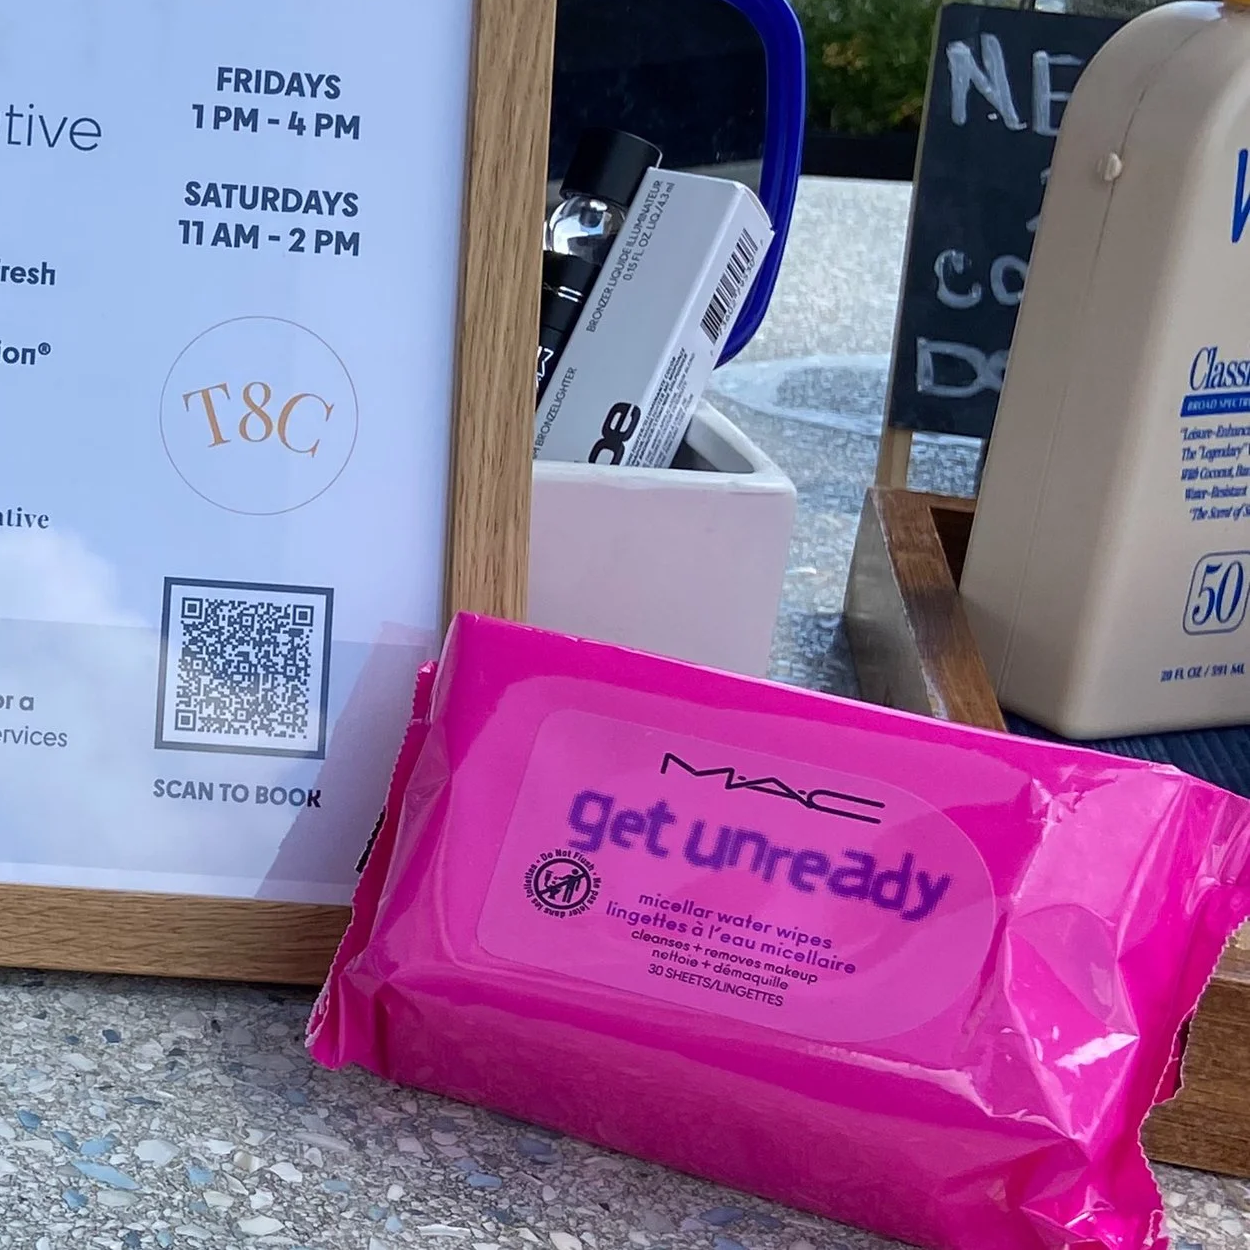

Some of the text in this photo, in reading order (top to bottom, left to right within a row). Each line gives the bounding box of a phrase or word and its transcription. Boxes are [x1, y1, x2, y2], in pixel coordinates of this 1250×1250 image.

[217, 66, 341, 100] FRIDAYS
[192, 104, 204, 129] 1
[213, 105, 259, 133] PM
[287, 111, 306, 136] 4
[314, 112, 360, 140] PM
[184, 181, 359, 217] SATURDAYS
[178, 219, 204, 246] 11
[210, 222, 259, 249] AM
[288, 227, 307, 253] 2
[314, 229, 360, 257] PM
[586, 287, 614, 333] BRONZER
[626, 180, 663, 247] ILLUMINATEUR
[183, 382, 334, 458] T8C
[1192, 561, 1244, 626] 50
[19, 696, 34, 711] a
[153, 779, 322, 808] SCAN TO BOOK
[540, 849, 595, 871] Do Not Flush
[567, 788, 953, 922] get unready
[606, 901, 688, 934] lingettes
[691, 921, 704, 938] à
[760, 942, 856, 975] micellaire
[639, 893, 833, 950] micellar water wipes
[631, 928, 818, 986] cleanses + removes makeup
[652, 948, 789, 991] nettoie + démaquille
[648, 963, 785, 1008] 30 SHEETS/LINGETTES
